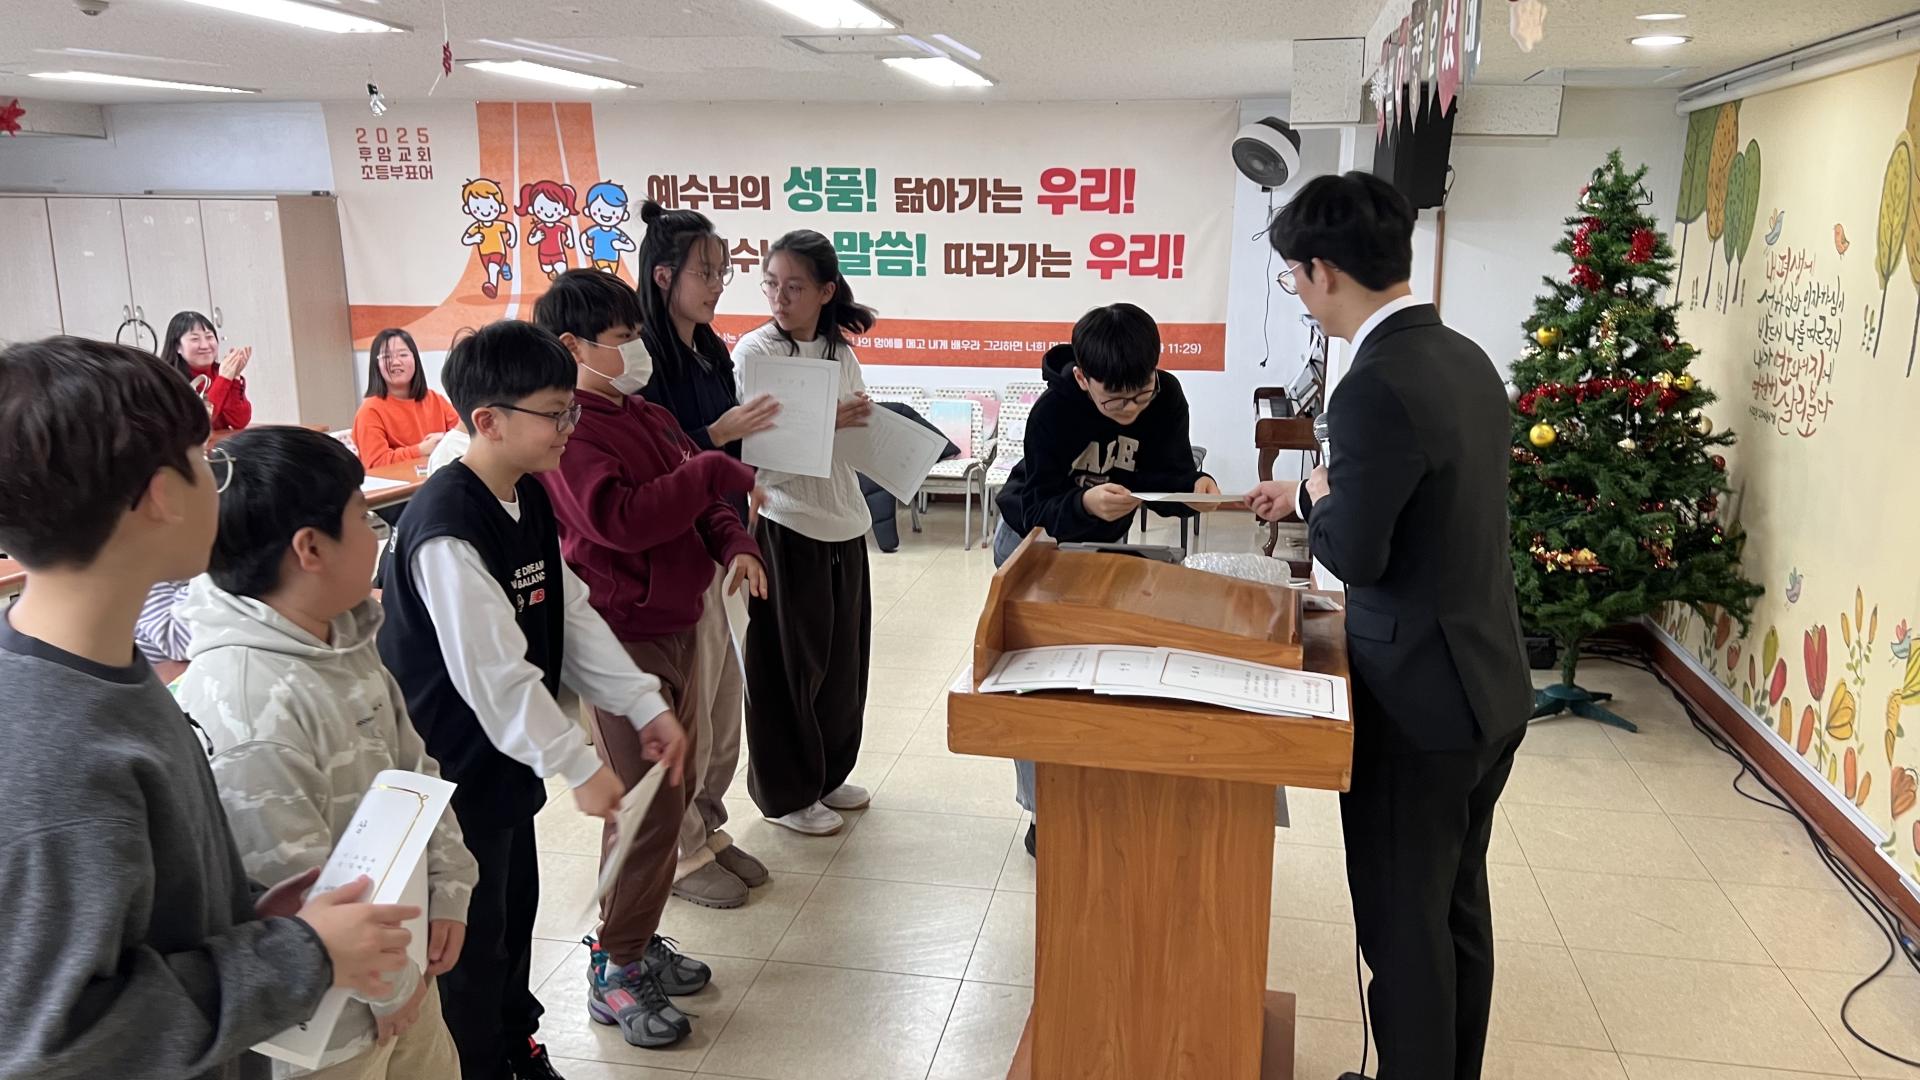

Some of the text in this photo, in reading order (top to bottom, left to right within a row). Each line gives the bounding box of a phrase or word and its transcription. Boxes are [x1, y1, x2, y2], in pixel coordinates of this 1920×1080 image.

[355, 127, 430, 144] 2025
[358, 146, 432, 162] 후암교회
[361, 164, 433, 180] 초등부표어
[647, 166, 1136, 216] 예수님의 성품! 닮아가는 우리!
[833, 231, 1185, 280] 말씀! 따라가는 우리!
[874, 337, 903, 349] 멍에를
[906, 338, 926, 349] 메고
[928, 339, 948, 350] 내게
[951, 339, 980, 351] 배우라
[983, 340, 1023, 352] 그리하면
[1026, 341, 1046, 352] 너희
[1168, 343, 1202, 355] 11:29)
